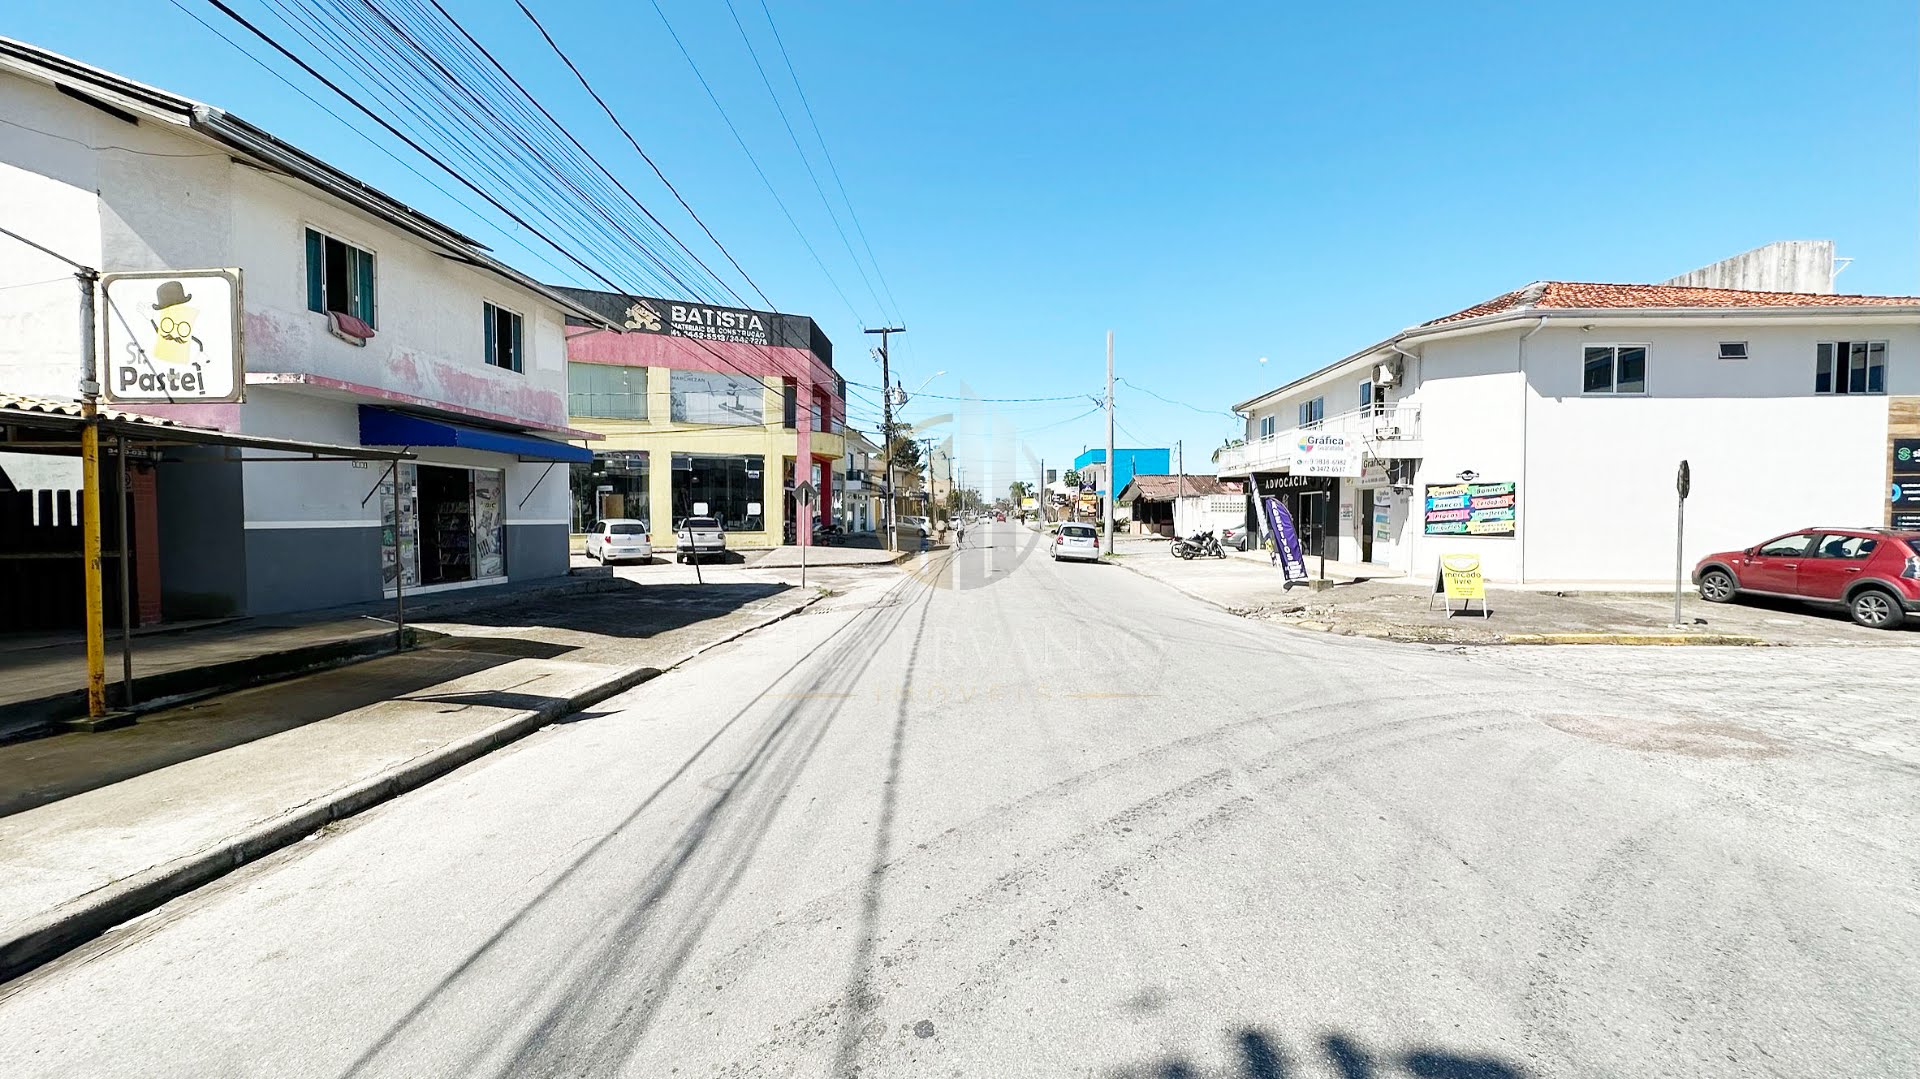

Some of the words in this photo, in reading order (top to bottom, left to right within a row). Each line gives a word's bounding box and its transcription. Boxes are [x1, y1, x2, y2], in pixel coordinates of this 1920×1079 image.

[671, 305, 764, 331] BATISTA
[1307, 435, 1344, 445] Gráfica
[1265, 476, 1308, 489] ADVOCACIA
[1476, 486, 1506, 494] Banners
[1271, 500, 1294, 561] ADESIVOS
